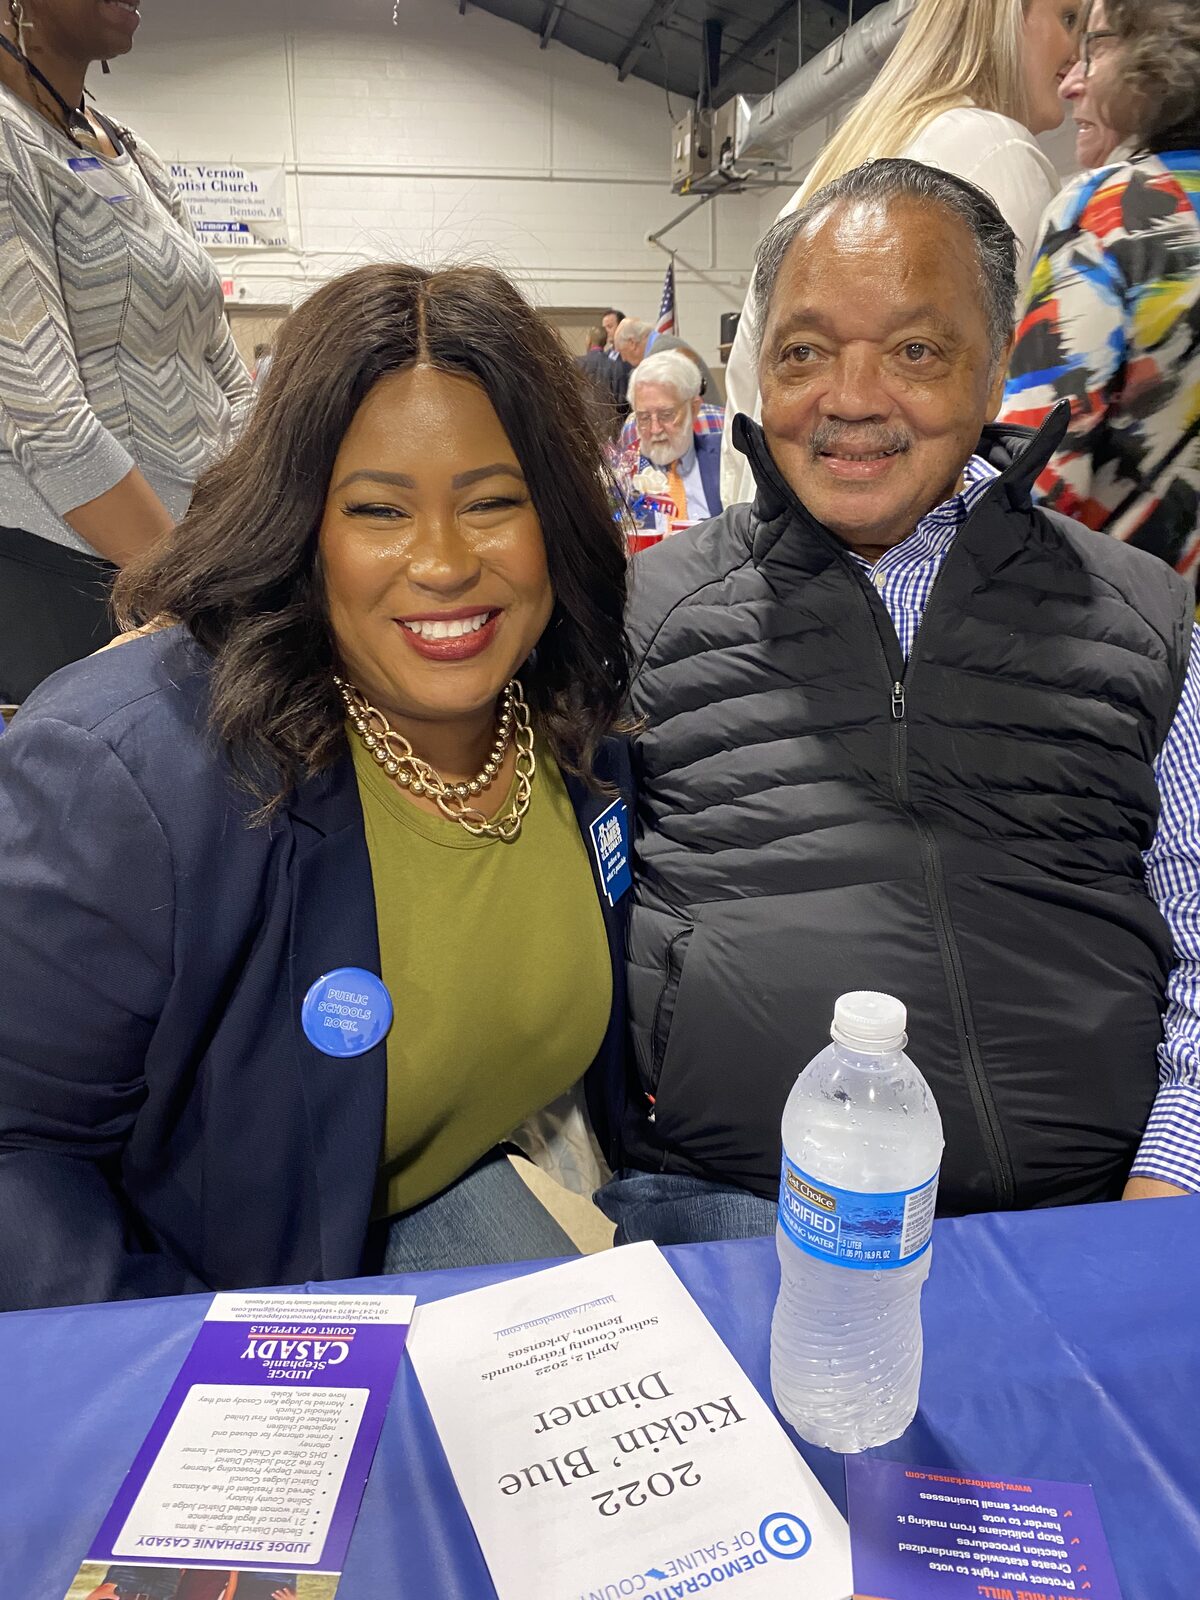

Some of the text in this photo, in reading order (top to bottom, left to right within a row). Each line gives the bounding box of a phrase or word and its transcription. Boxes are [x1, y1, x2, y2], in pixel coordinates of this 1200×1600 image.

[170, 166, 244, 178] Mt. Vernon
[177, 180, 258, 192] ptist Church
[230, 207, 266, 217] Benton,
[268, 208, 283, 216] AR
[212, 234, 222, 244] &
[229, 234, 249, 245] Jim
[253, 235, 288, 246] Evans
[328, 989, 368, 1005] PUBLIC
[318, 1001, 371, 1020] SCHOOLS
[324, 1016, 358, 1032] ROCK.
[800, 1184, 834, 1208] Choice
[784, 1191, 836, 1234] PURIFIED
[807, 1232, 834, 1250] WATER
[847, 1241, 862, 1250] LITER
[494, 1295, 616, 1340] https://salinedems.com/
[250, 1326, 301, 1334] APPEALS
[300, 1326, 316, 1334] OF
[508, 1314, 623, 1359] Benton, Arkansas
[240, 1340, 349, 1364] CASADY
[480, 1316, 658, 1382] Saline County Fairgrounds
[586, 1341, 620, 1360] April
[262, 1359, 326, 1369] Stephanie
[535, 1360, 568, 1376] 2022
[266, 1370, 314, 1379] JUDGE
[198, 1396, 214, 1404] they
[233, 1397, 262, 1405] Casady
[280, 1398, 302, 1406] Judge
[534, 1371, 674, 1434] Dinner
[304, 1408, 342, 1416] Methodist
[251, 1414, 267, 1422] First
[298, 1424, 336, 1432] neglected
[273, 1432, 304, 1440] attorney
[298, 1440, 330, 1448] attorney
[216, 1448, 248, 1456] Counsel
[283, 1450, 307, 1458] Office
[244, 1458, 274, 1466] Judicial
[313, 1460, 325, 1468] for
[180, 1464, 215, 1472] Attorney
[216, 1466, 262, 1474] Prosecuting
[264, 1467, 292, 1476] Deputy
[498, 1446, 599, 1497] Blue
[228, 1476, 318, 1486] District Judges Council
[906, 1471, 1032, 1492] www.joshforarkansas.com
[236, 1486, 274, 1494] President
[286, 1488, 316, 1496] Served
[592, 1461, 702, 1516] 2022
[226, 1494, 254, 1503] history
[255, 1495, 284, 1504] County
[172, 1501, 198, 1510] Judge
[198, 1504, 226, 1512] District
[228, 1505, 258, 1513] elected
[920, 1492, 1058, 1517] Support small businesses
[234, 1514, 256, 1524] legal
[258, 1516, 266, 1524] of
[294, 1518, 306, 1526] 21
[982, 1514, 1061, 1532] harder to vote
[198, 1524, 206, 1532] 3
[216, 1524, 242, 1533] Judge
[242, 1526, 270, 1534] District
[272, 1528, 303, 1536] Elected
[897, 1515, 1064, 1544] Stop politicians from making it
[772, 1524, 798, 1546] D
[136, 1536, 310, 1553] JUDGE STEPHANIE CASADY
[732, 1531, 755, 1551] OF
[957, 1538, 1068, 1559] election procedures
[665, 1541, 728, 1577] SALINE
[898, 1543, 1072, 1574] Create statewide standardized
[930, 1562, 1075, 1590] Protect your right to vote
[978, 1586, 1014, 1600] WILL:
